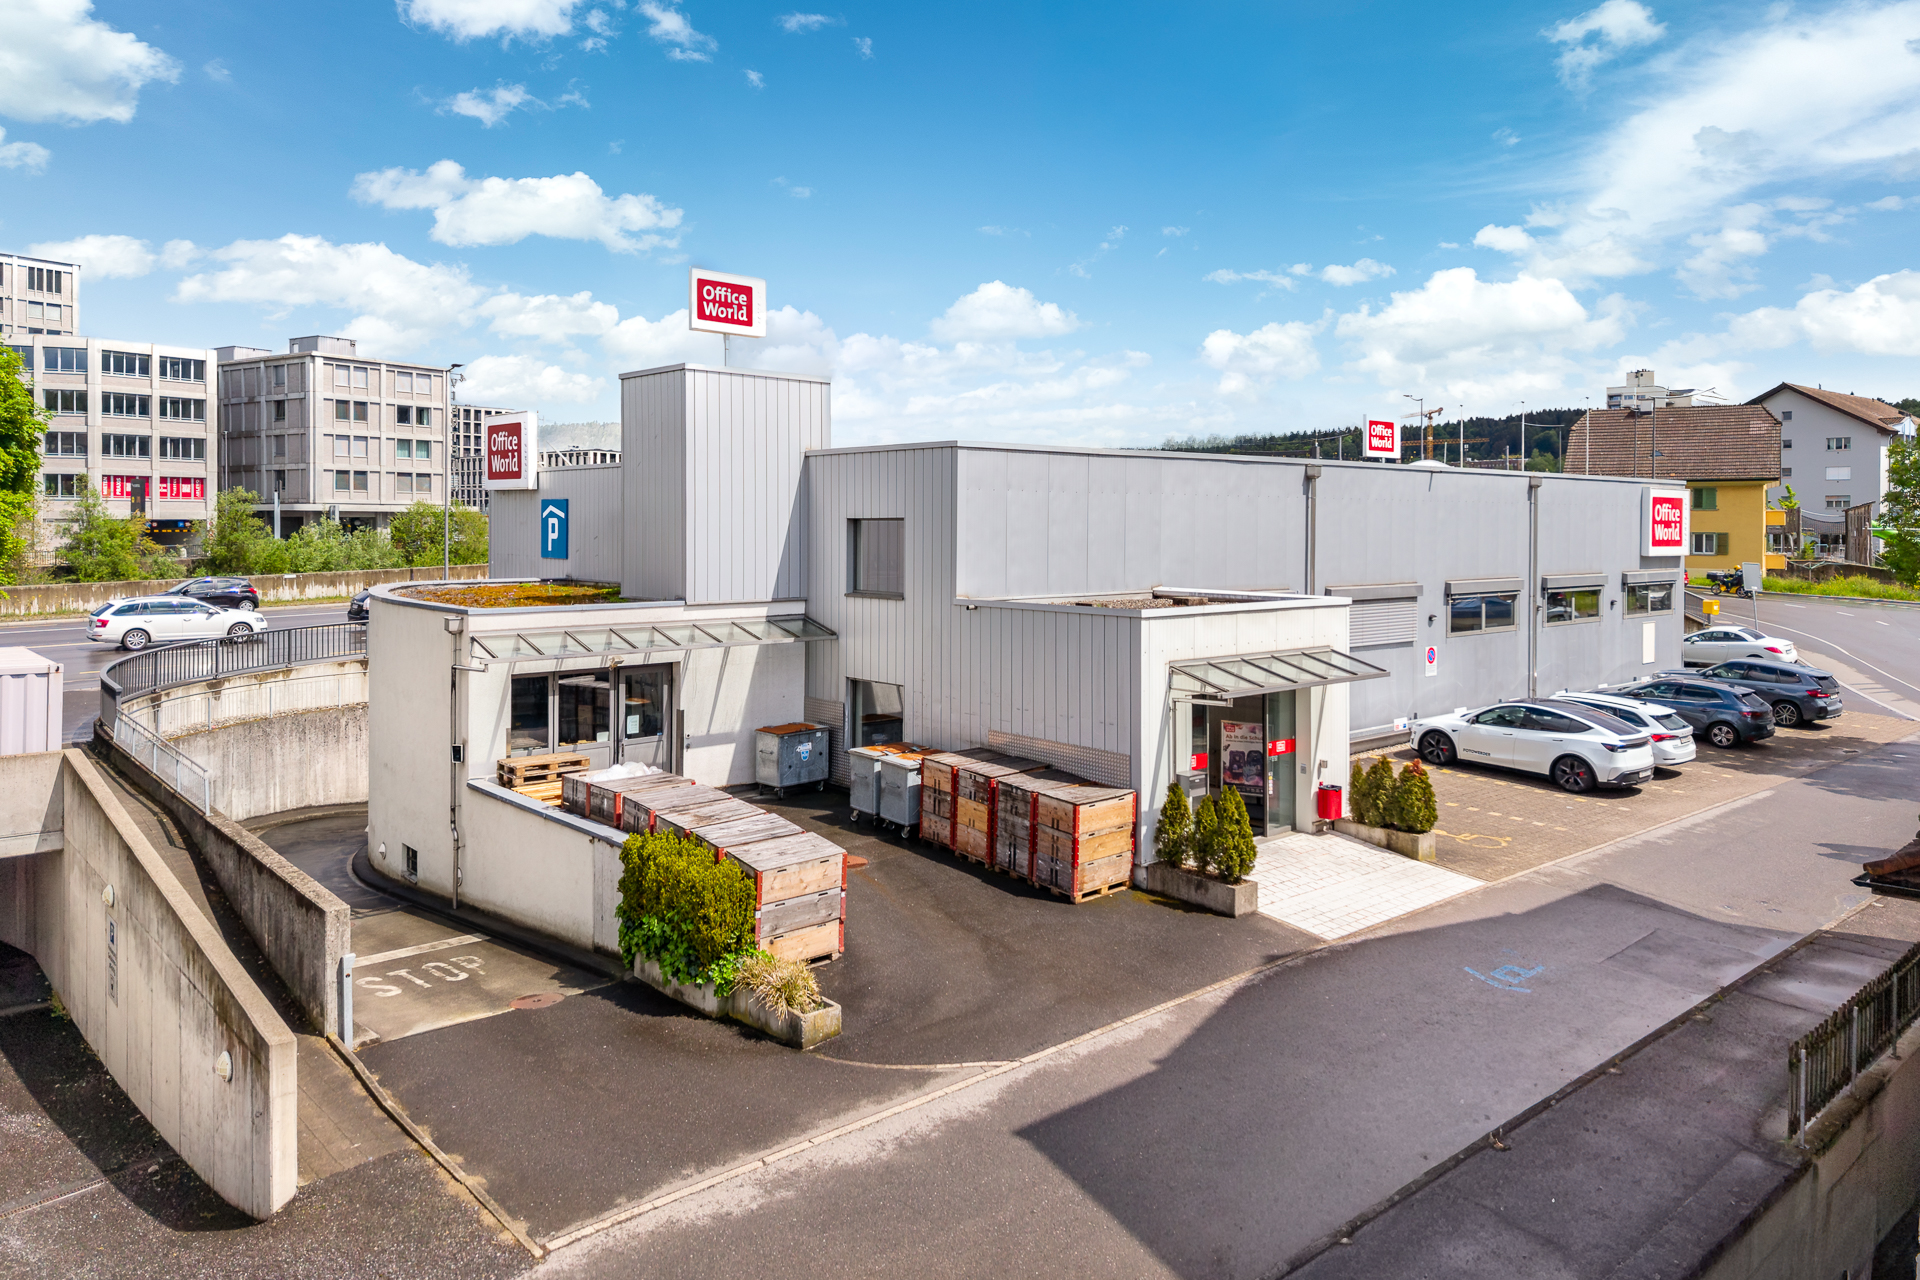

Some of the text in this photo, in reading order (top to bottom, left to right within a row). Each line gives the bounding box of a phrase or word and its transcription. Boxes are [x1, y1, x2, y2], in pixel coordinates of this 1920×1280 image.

[702, 285, 748, 305] Office
[702, 301, 749, 321] World
[1370, 424, 1393, 437] Office
[490, 432, 519, 451] Office
[1370, 436, 1393, 449] World
[490, 452, 520, 473] World
[1653, 504, 1681, 522] Office
[547, 517, 559, 552] P
[1653, 523, 1681, 541] World
[355, 955, 486, 997] STOP
